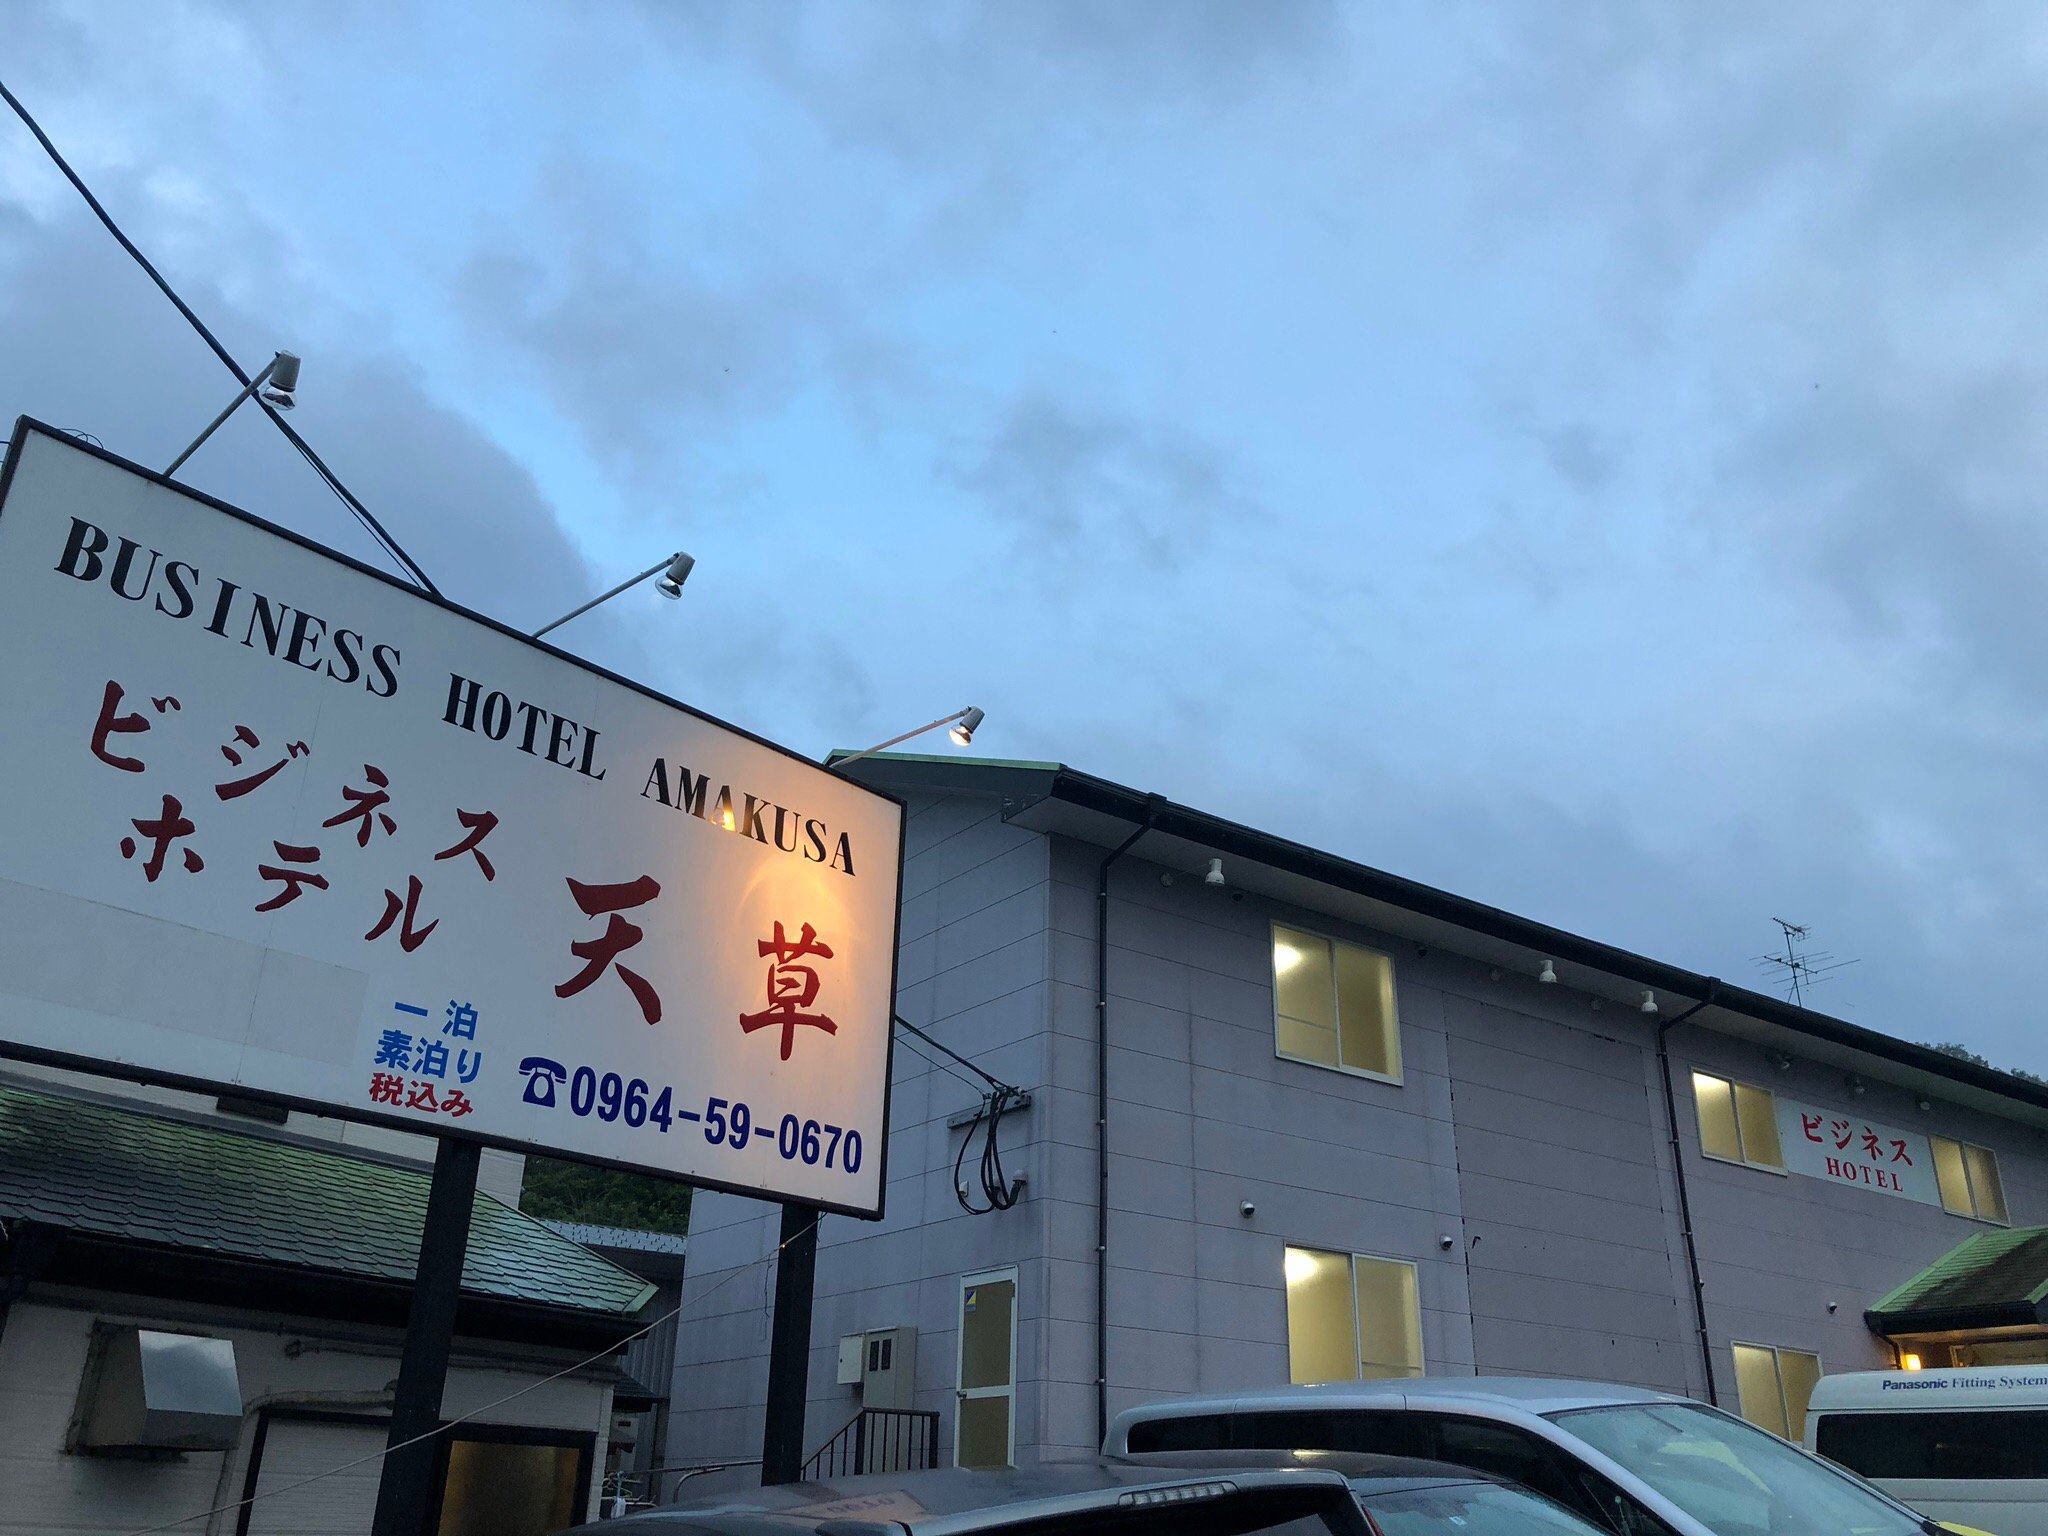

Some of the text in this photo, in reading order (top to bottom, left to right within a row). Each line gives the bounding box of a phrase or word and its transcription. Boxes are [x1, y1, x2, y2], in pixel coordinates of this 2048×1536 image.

[54, 516, 857, 877] BUSINESS HOTEL AMAKUSA
[91, 680, 499, 882] ビジネス
[120, 794, 440, 953] ホテル
[554, 875, 839, 1062] 天草
[368, 1072, 474, 1118] 税込み
[374, 1029, 482, 1084] 素泊り
[570, 1066, 863, 1175] 0964-59-0670
[1801, 1112, 1913, 1167] ビジネス
[1825, 1156, 1905, 1193] HOTEL
[1882, 1378, 1948, 1390] Panasonic
[1952, 1377, 1996, 1389] Fitting
